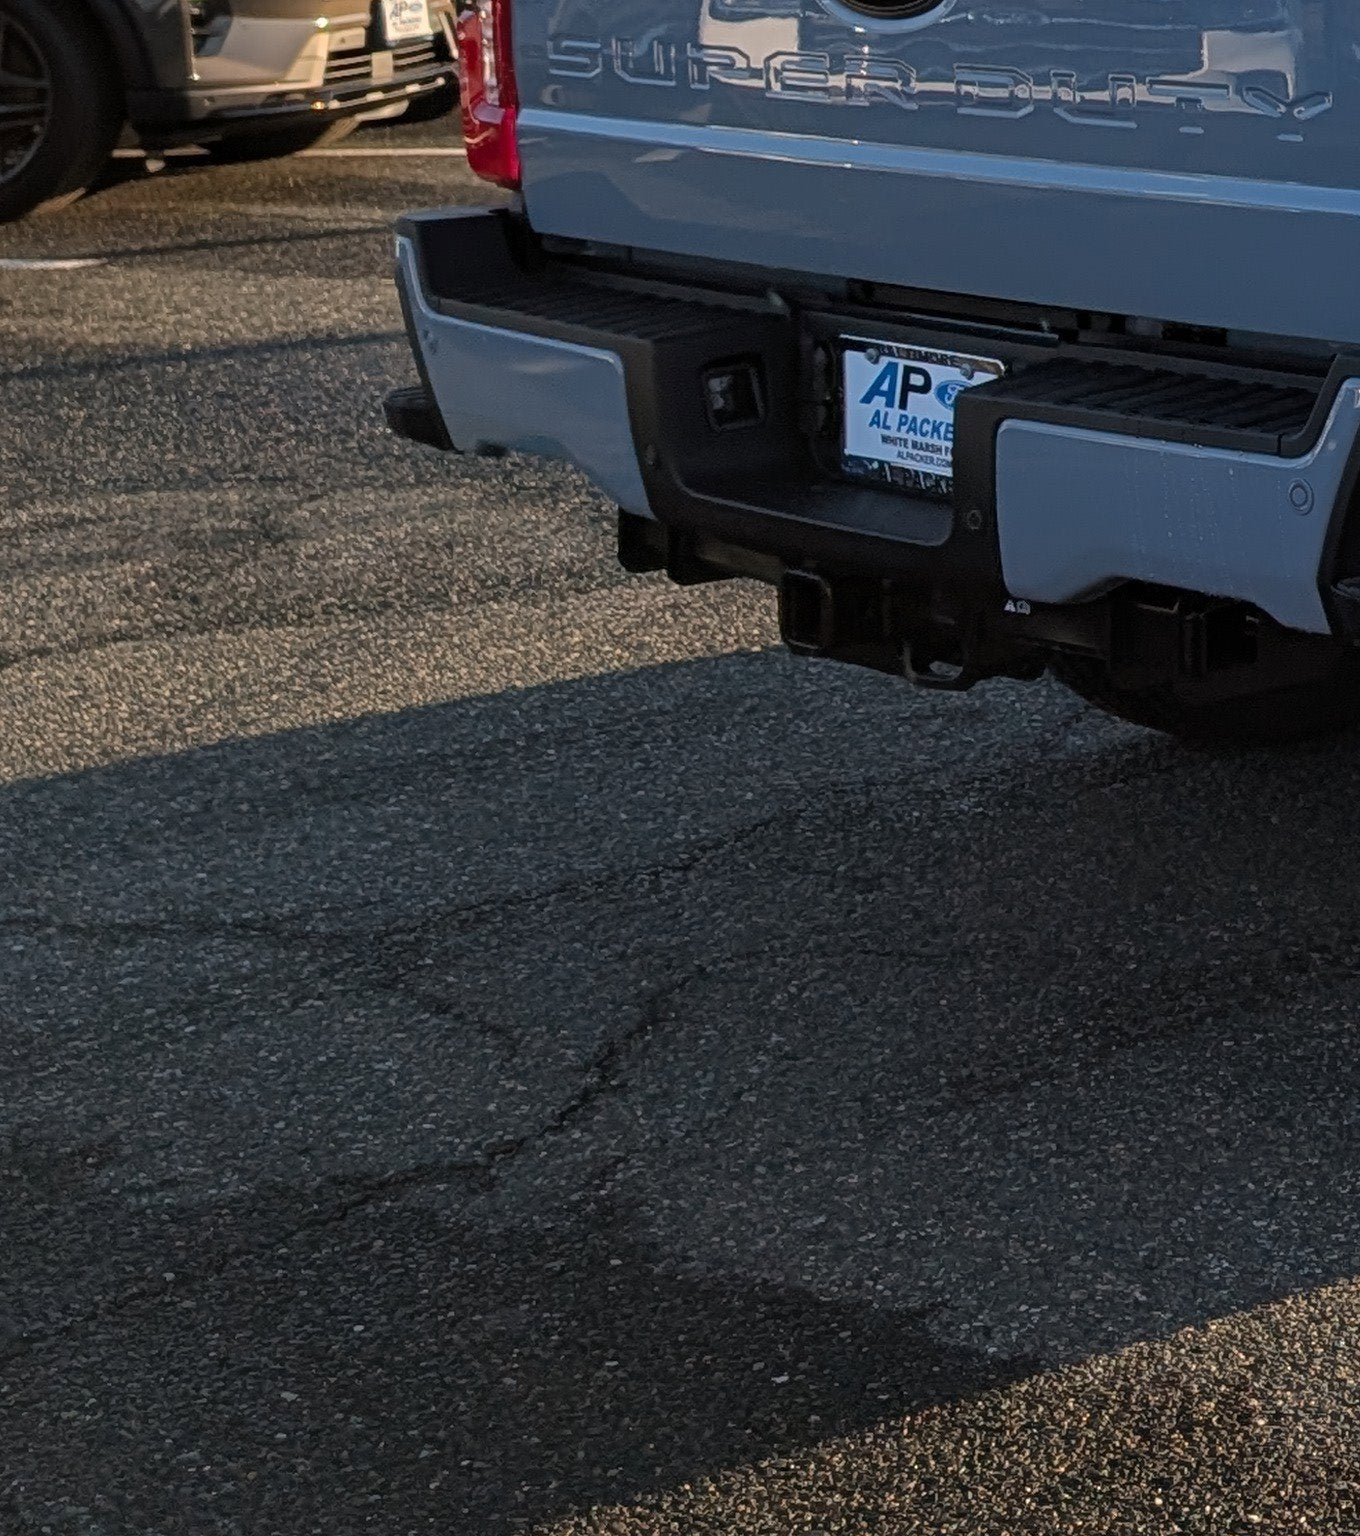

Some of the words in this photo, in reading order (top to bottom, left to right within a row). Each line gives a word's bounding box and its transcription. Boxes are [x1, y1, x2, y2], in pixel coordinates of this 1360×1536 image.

[545, 36, 919, 110] SUPER
[953, 62, 1334, 143] DUTY
[859, 360, 932, 411] AP
[868, 409, 891, 431] AL
[896, 413, 954, 443] PACKE
[881, 433, 909, 449] WHITE
[911, 440, 943, 456] MARSH
